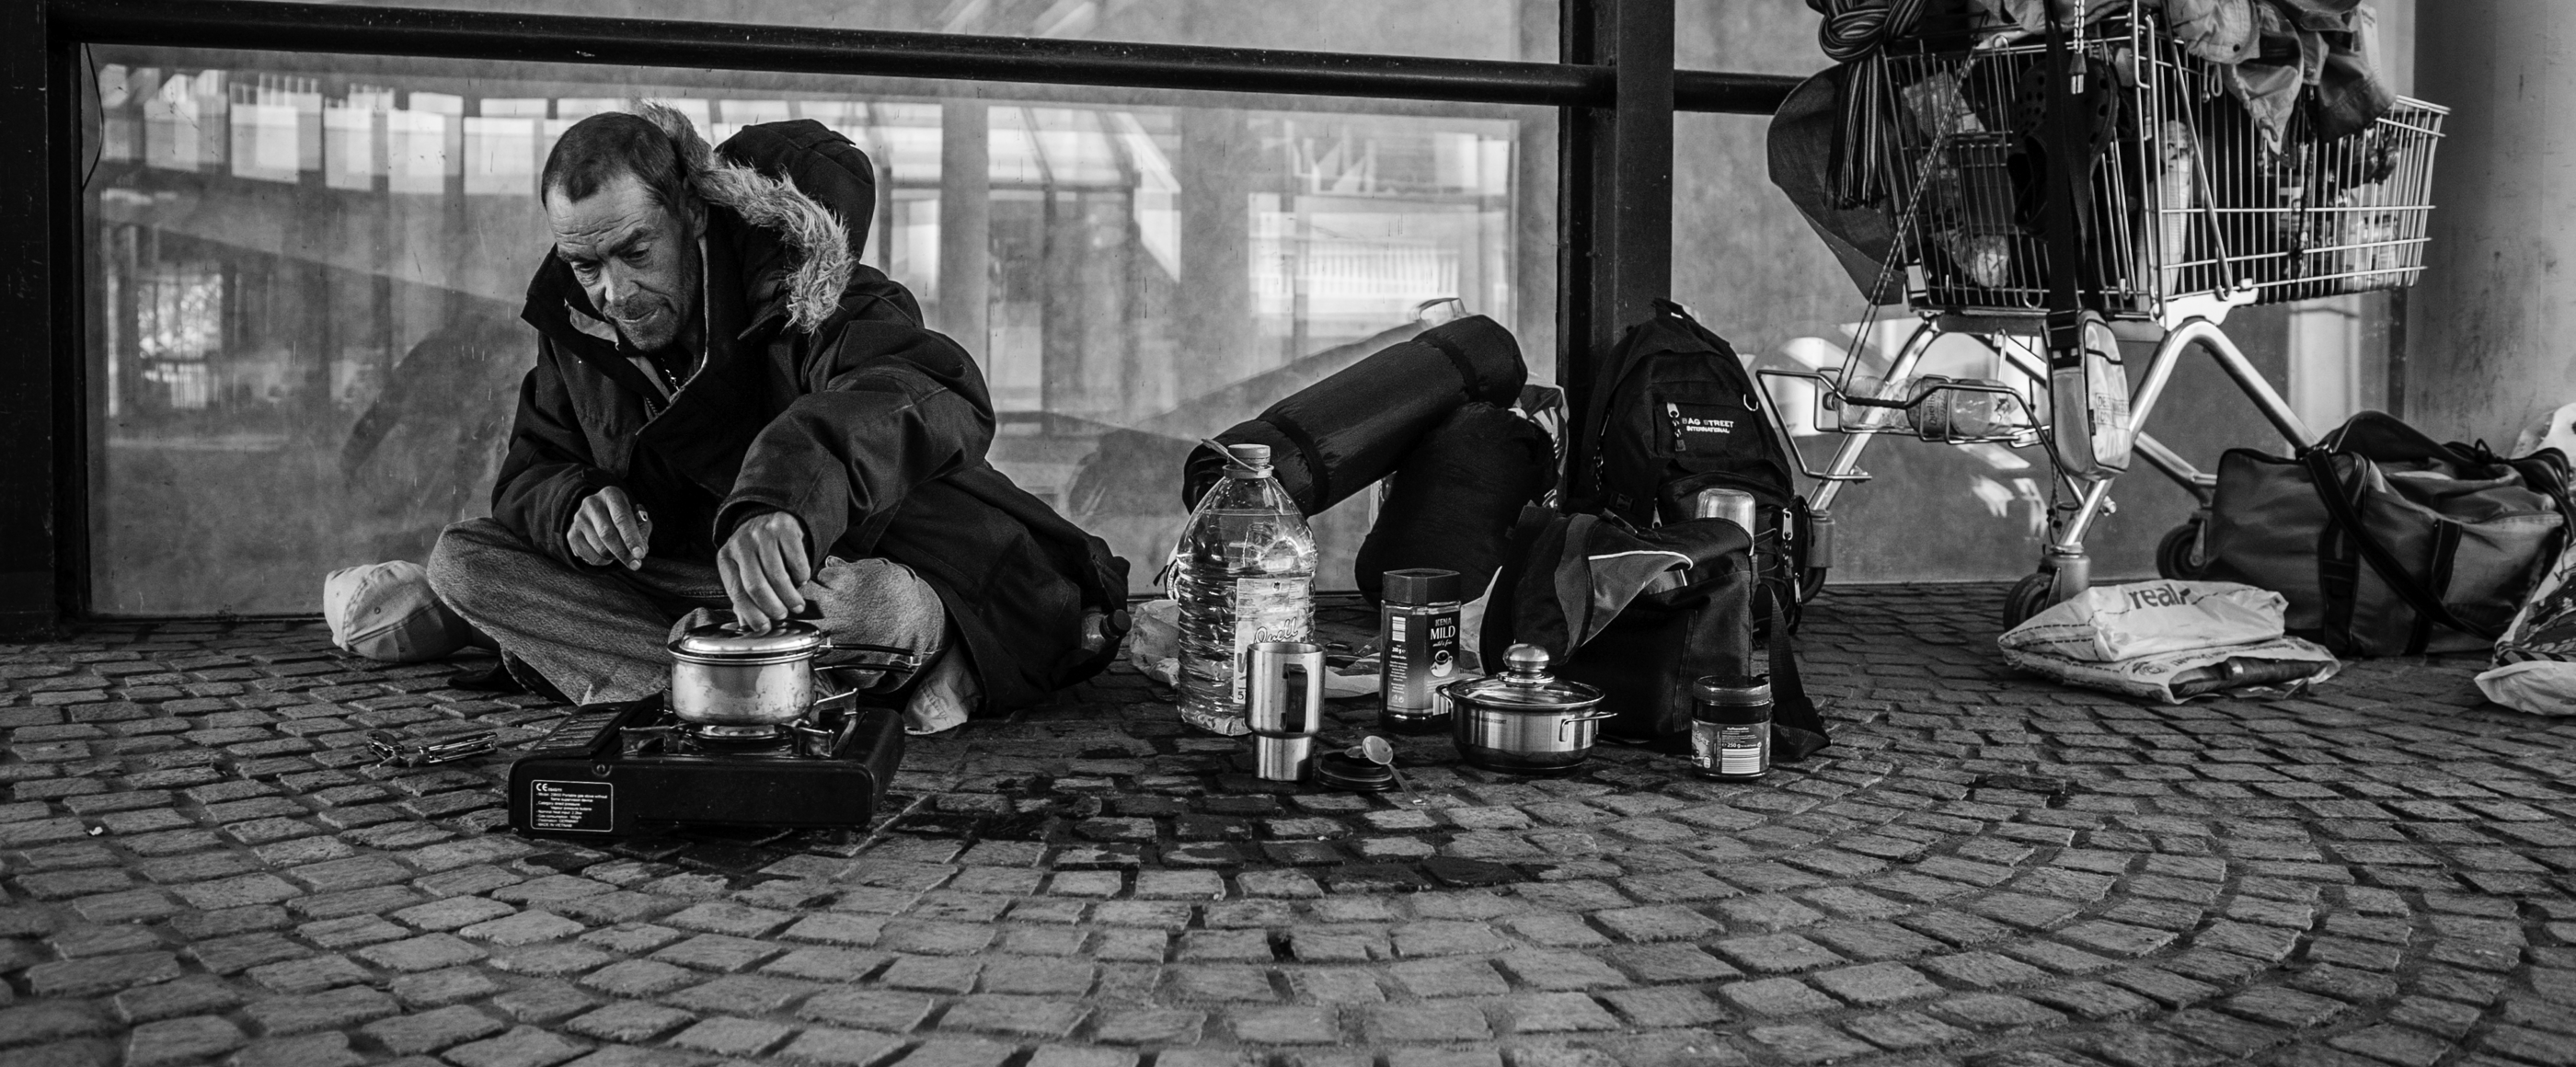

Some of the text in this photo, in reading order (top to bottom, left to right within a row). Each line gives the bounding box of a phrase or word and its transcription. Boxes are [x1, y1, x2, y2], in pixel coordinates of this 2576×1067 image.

[1703, 419, 1734, 428] STREET
[1686, 425, 1730, 434] INTERNATIONAL
[1430, 625, 1456, 640] MILD
[536, 783, 548, 792] CE
